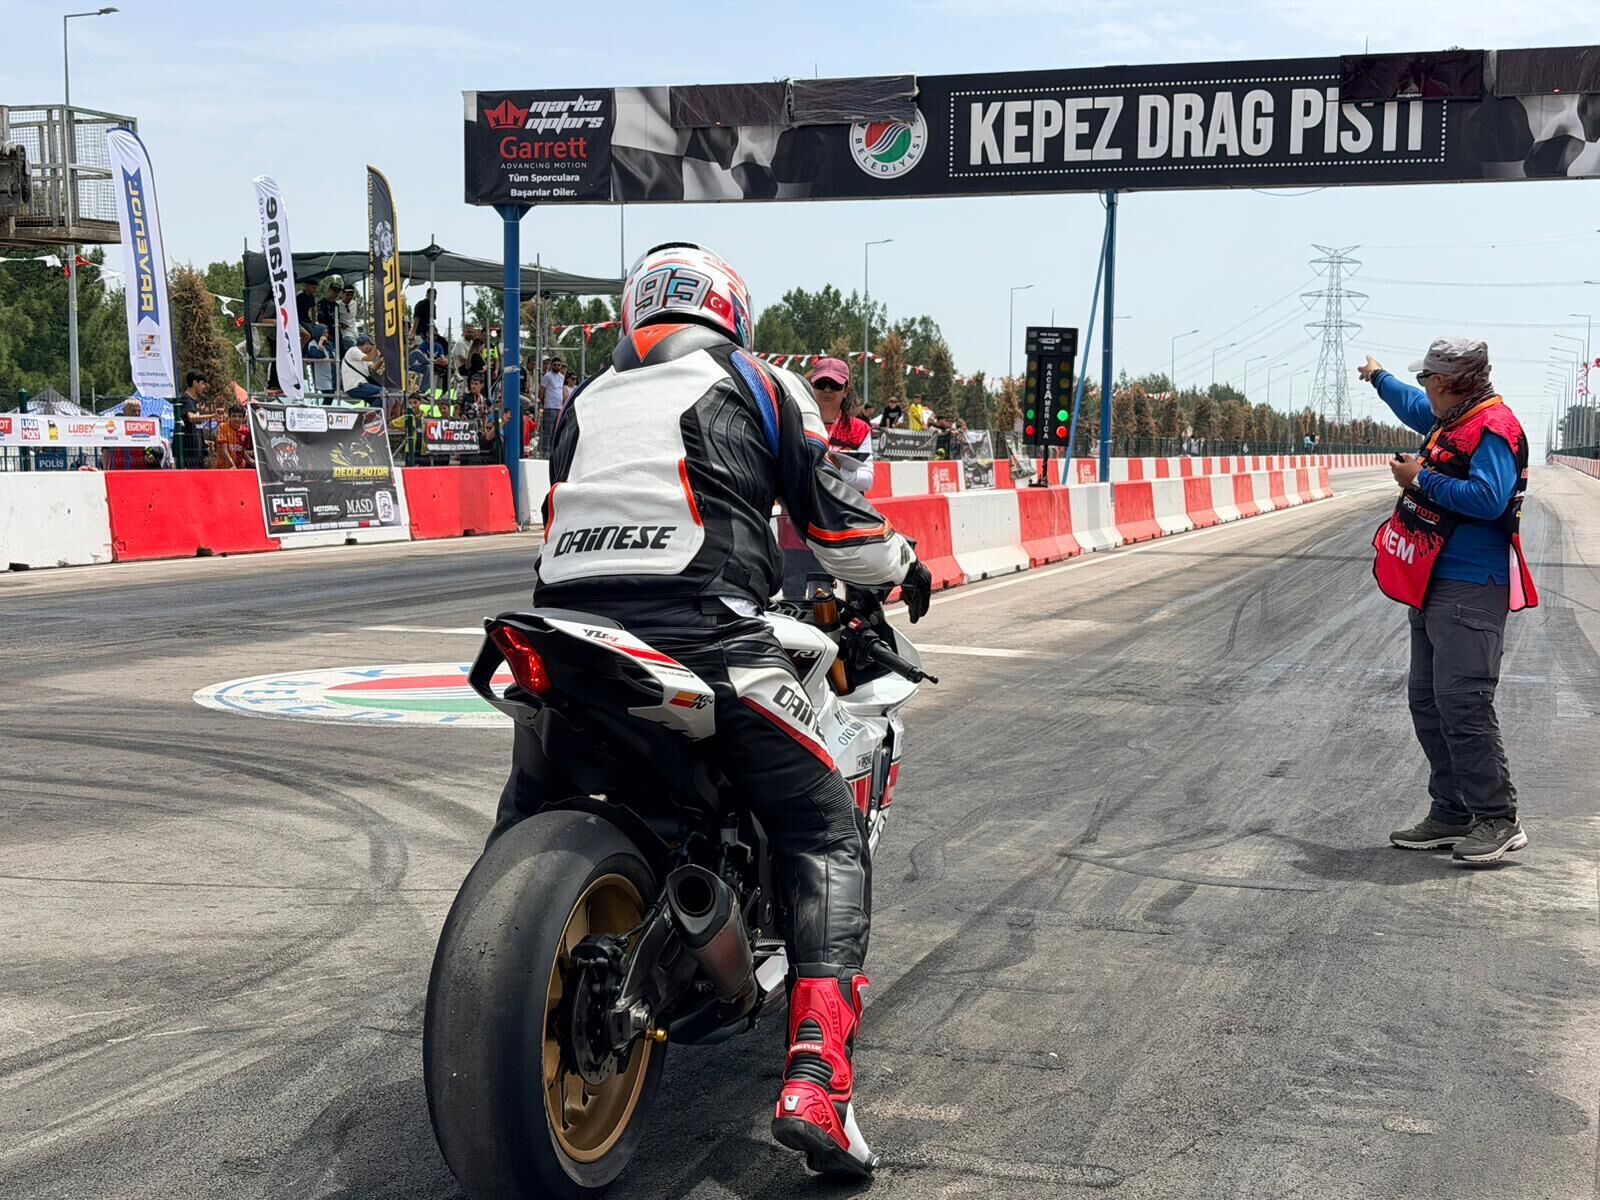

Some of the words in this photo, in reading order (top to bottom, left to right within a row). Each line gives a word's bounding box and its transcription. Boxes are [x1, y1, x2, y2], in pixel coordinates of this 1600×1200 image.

[529, 95, 603, 118] marka
[525, 112, 605, 135] motors
[970, 96, 1124, 165] KEPEZ
[1137, 89, 1275, 160] DRAG
[499, 136, 588, 160] Garrett
[508, 174, 529, 182] Tüm
[531, 173, 580, 183] Sporculara
[510, 188, 551, 199] Başarılar
[553, 188, 578, 197] Diler.
[271, 496, 304, 513] PLUS
[554, 526, 677, 558] DAINESE
